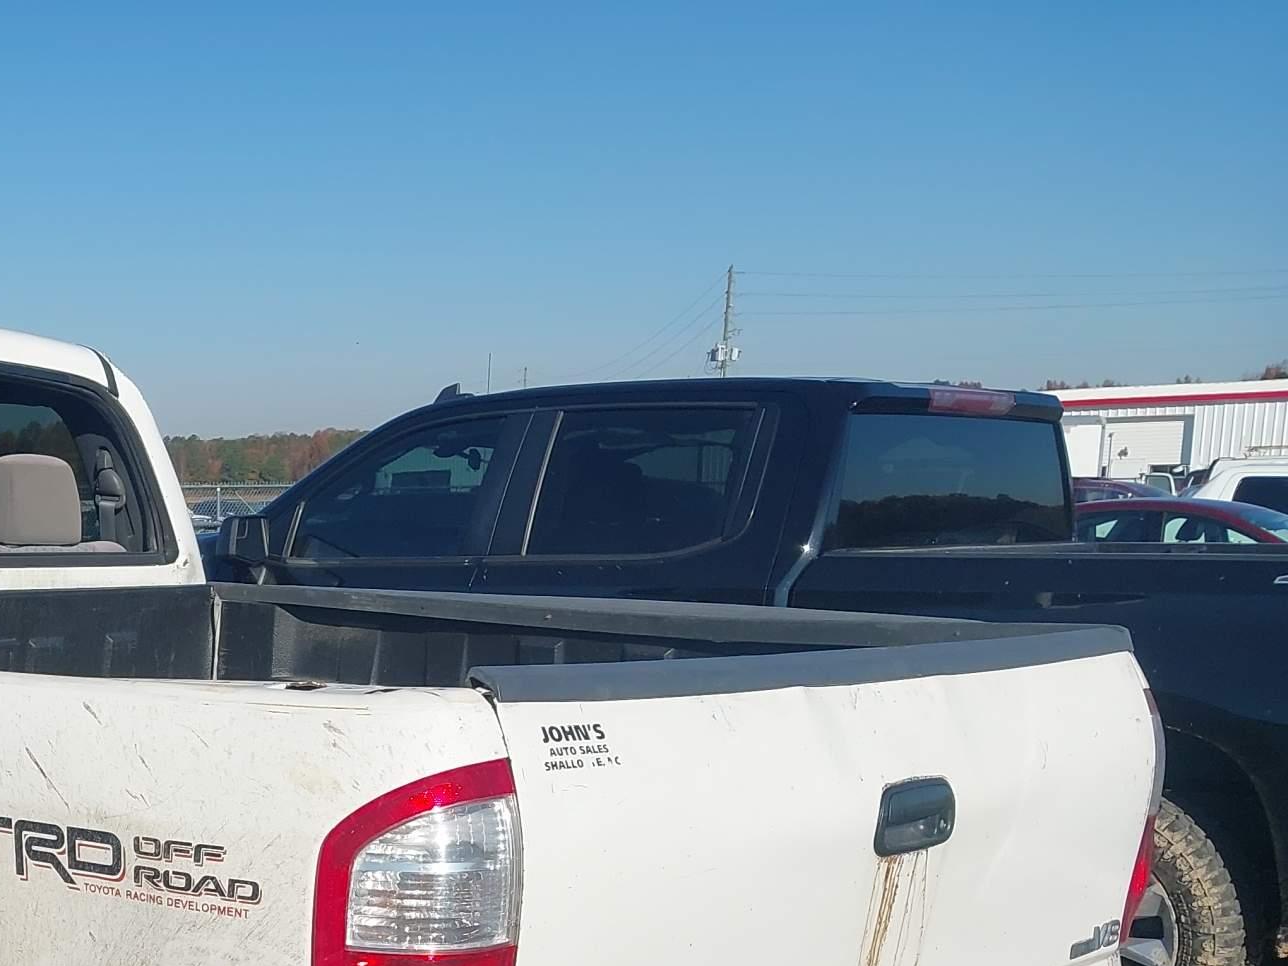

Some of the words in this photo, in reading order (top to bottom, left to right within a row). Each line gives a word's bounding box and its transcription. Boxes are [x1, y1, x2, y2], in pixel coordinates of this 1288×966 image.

[541, 723, 605, 743] JOHN'S
[550, 746, 577, 757] AUTO
[579, 744, 609, 755] SALES
[133, 835, 227, 867] OFF
[133, 865, 263, 905] ROAD
[84, 882, 122, 898] TOYOTA
[126, 890, 163, 906] RACING
[167, 897, 250, 920] DEVELOPMENT
[1094, 920, 1120, 949] V8
